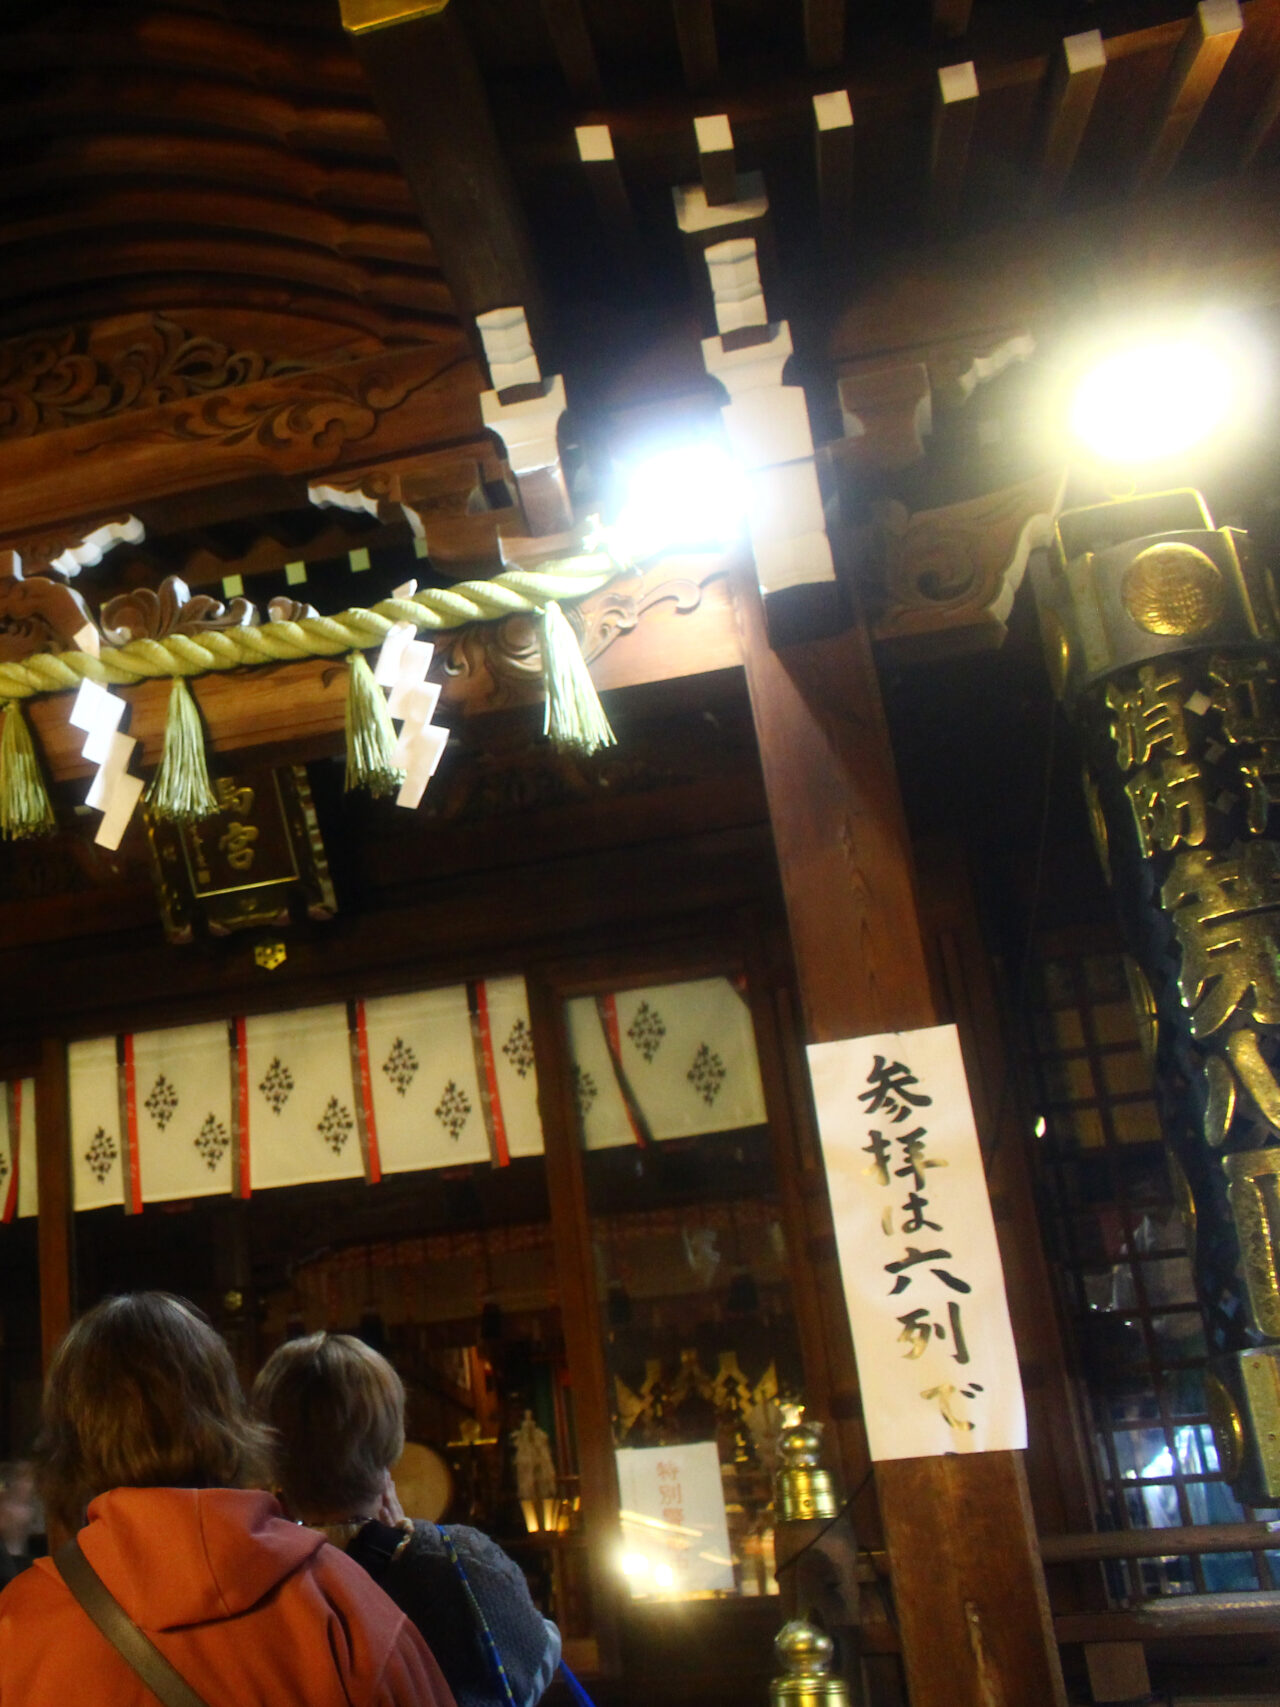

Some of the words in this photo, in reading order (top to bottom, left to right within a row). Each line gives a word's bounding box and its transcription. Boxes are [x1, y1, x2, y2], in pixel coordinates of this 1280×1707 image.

[856, 1054, 985, 1433] 参拝は六列で
